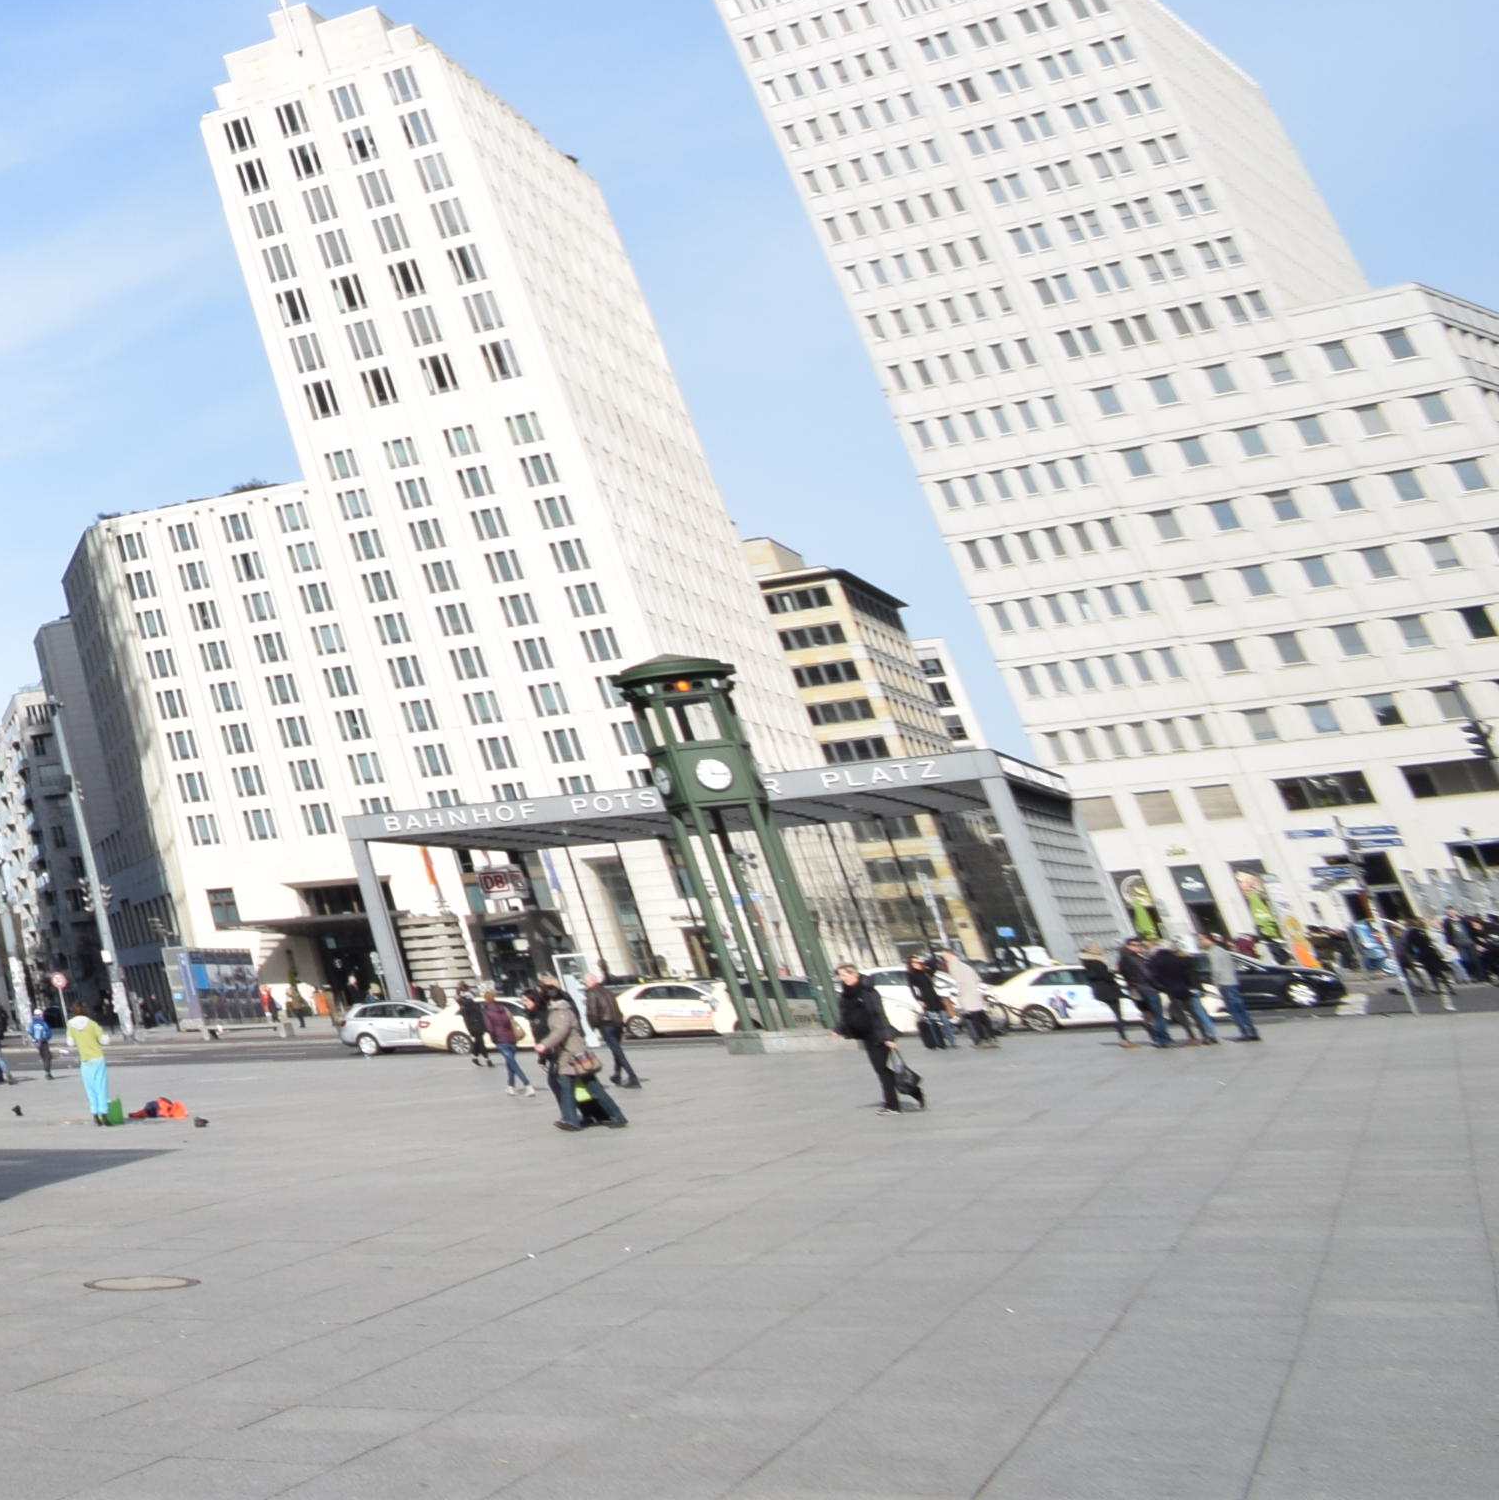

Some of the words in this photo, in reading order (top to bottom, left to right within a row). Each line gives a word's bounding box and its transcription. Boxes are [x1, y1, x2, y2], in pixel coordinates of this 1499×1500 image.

[383, 803, 536, 833] BAHNHOF
[569, 778, 783, 817] POTSR
[819, 760, 942, 790] PLATZ
[482, 874, 505, 890] DB
